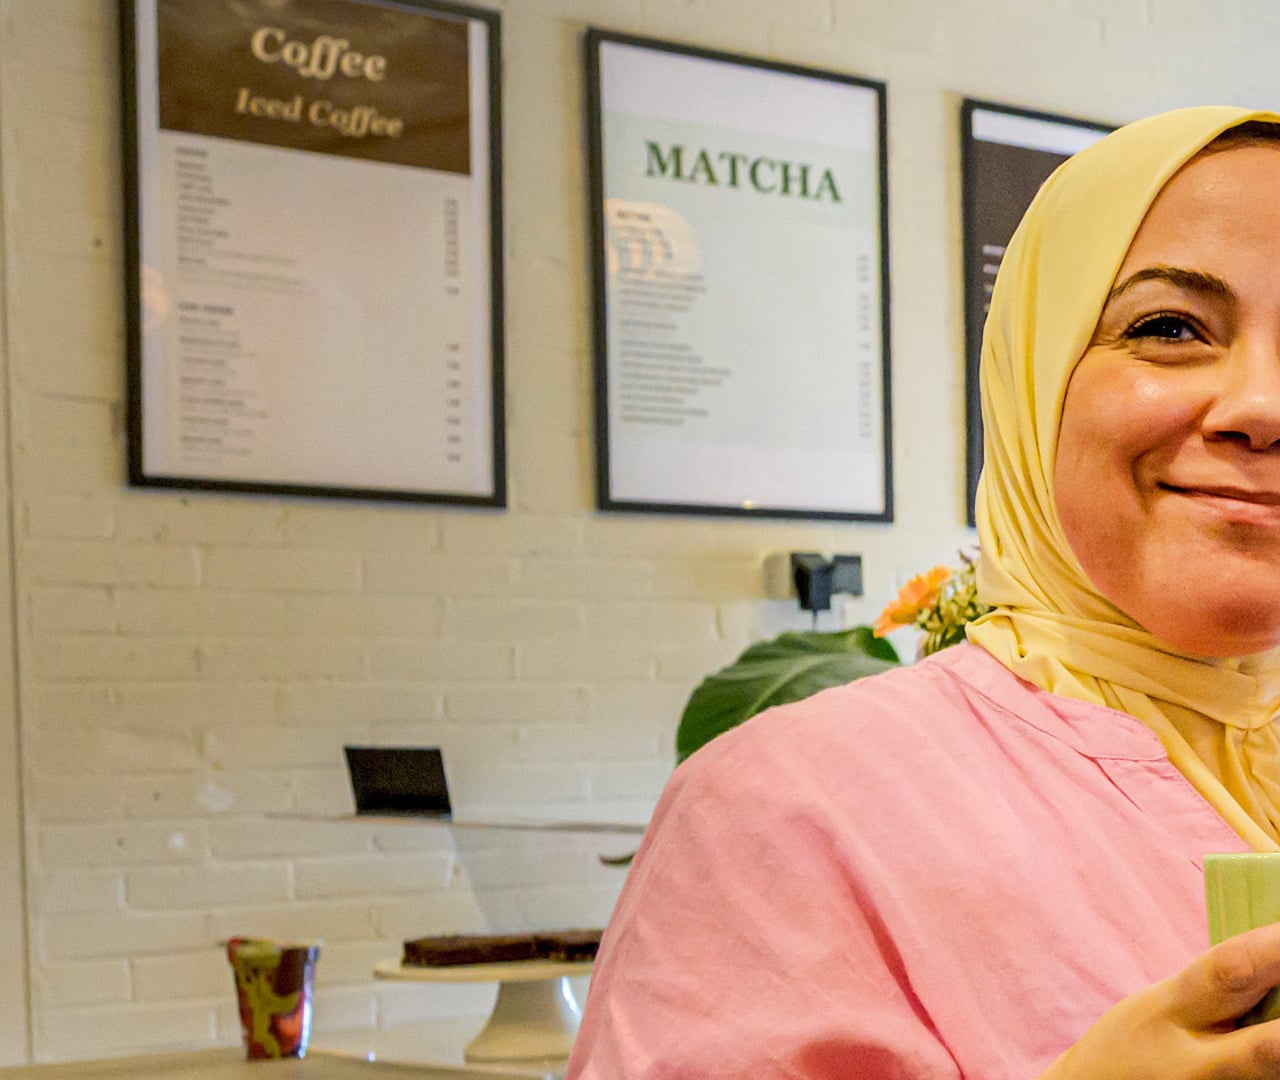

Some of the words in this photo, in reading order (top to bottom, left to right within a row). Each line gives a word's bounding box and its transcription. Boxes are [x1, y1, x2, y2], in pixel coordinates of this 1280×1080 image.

[252, 27, 386, 81] Coffee
[234, 88, 303, 122] Iced
[308, 101, 403, 138] Coffee
[645, 140, 843, 203] MATCHA
